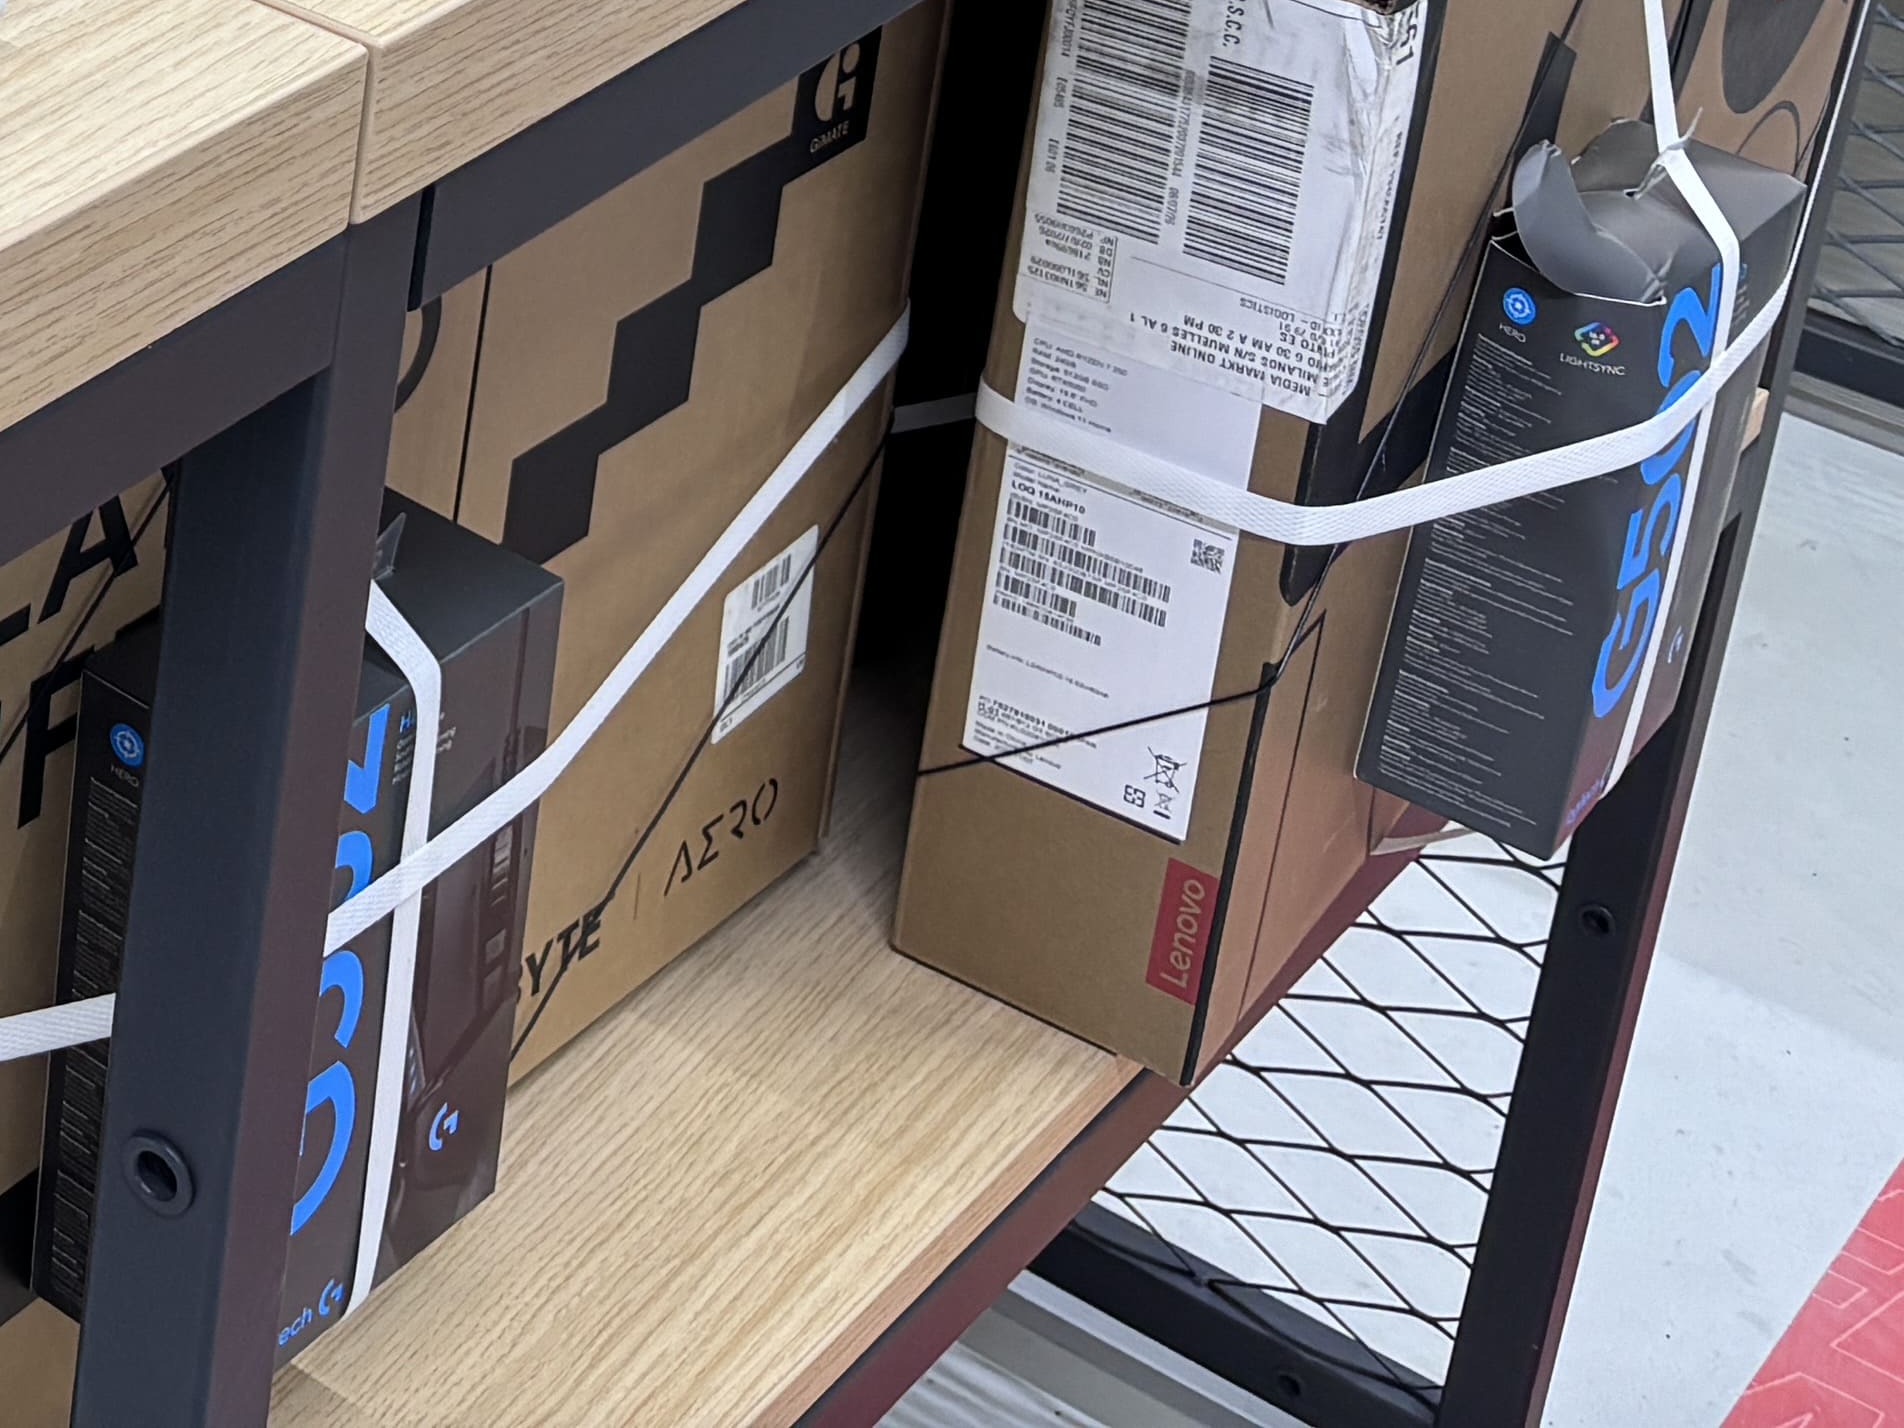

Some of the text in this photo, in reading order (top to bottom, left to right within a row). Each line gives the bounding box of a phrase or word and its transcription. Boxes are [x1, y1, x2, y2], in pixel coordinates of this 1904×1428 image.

[1498, 321, 1527, 344] HERO
[1169, 340, 1311, 397] MEDIA MARKT ONLINE
[1558, 351, 1627, 377] LIGHTSYNC
[109, 764, 140, 788] HERO
[1159, 879, 1206, 989] Lenovo
